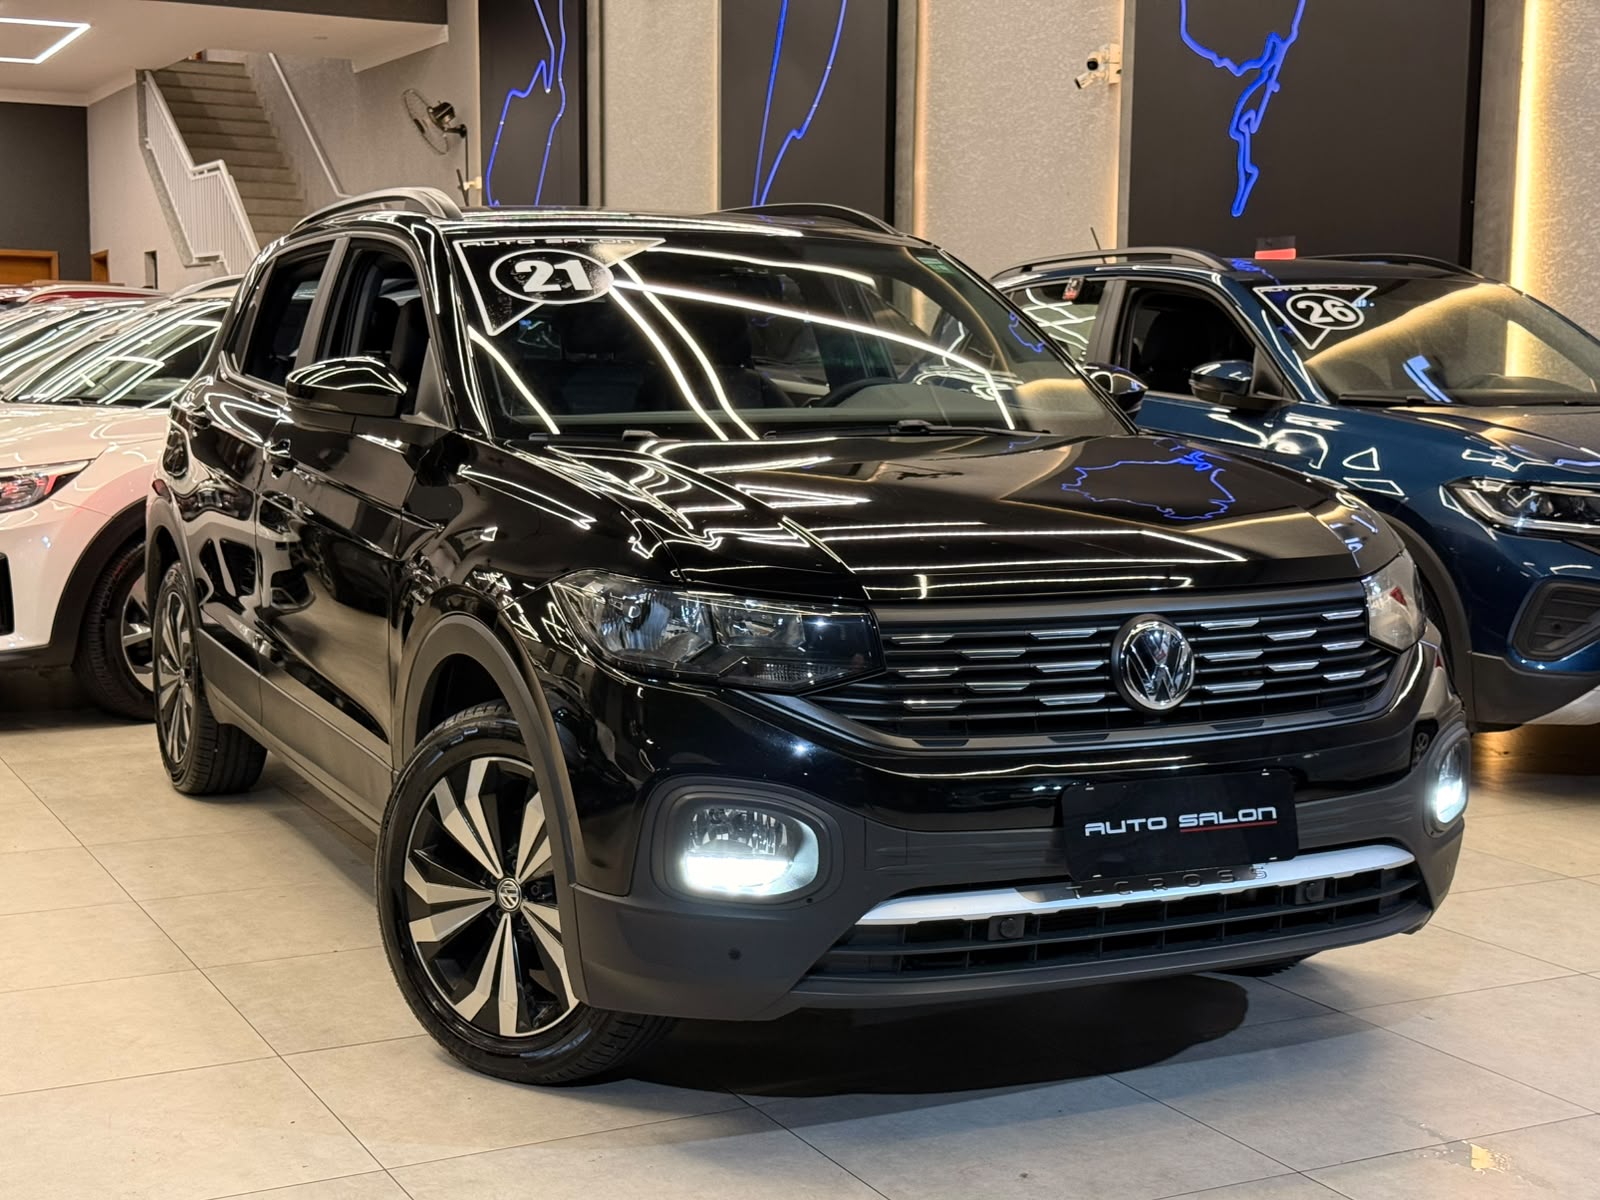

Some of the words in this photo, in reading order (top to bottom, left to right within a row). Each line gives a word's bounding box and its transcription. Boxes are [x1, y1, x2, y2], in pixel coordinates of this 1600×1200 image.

[462, 238, 535, 247] AUTO
[514, 260, 593, 293] 21
[1296, 299, 1357, 323] 26
[1084, 816, 1168, 837] AUTO
[1178, 806, 1278, 828] SALON
